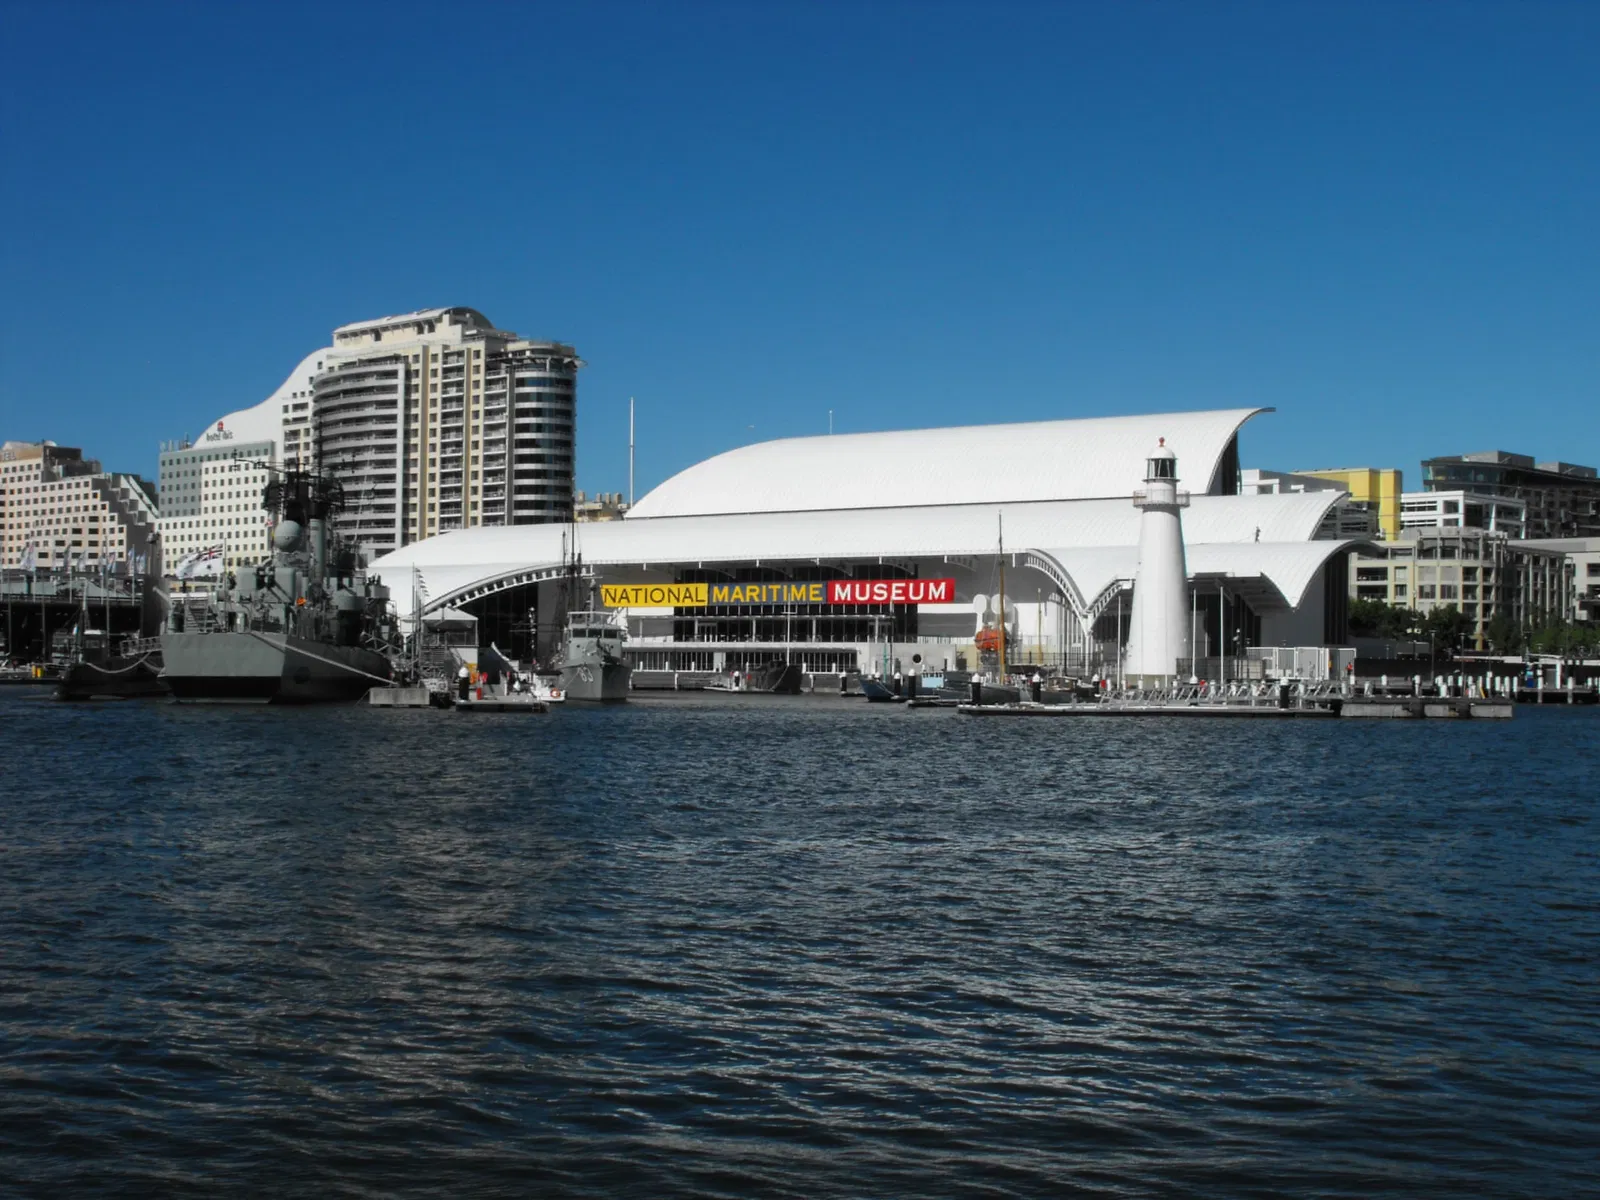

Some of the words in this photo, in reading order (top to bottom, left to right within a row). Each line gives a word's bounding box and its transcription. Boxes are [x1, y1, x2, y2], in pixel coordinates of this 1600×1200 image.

[604, 586, 706, 604] NATIONAL
[712, 584, 823, 603] MARITIME
[834, 582, 946, 602] MUSEUM
